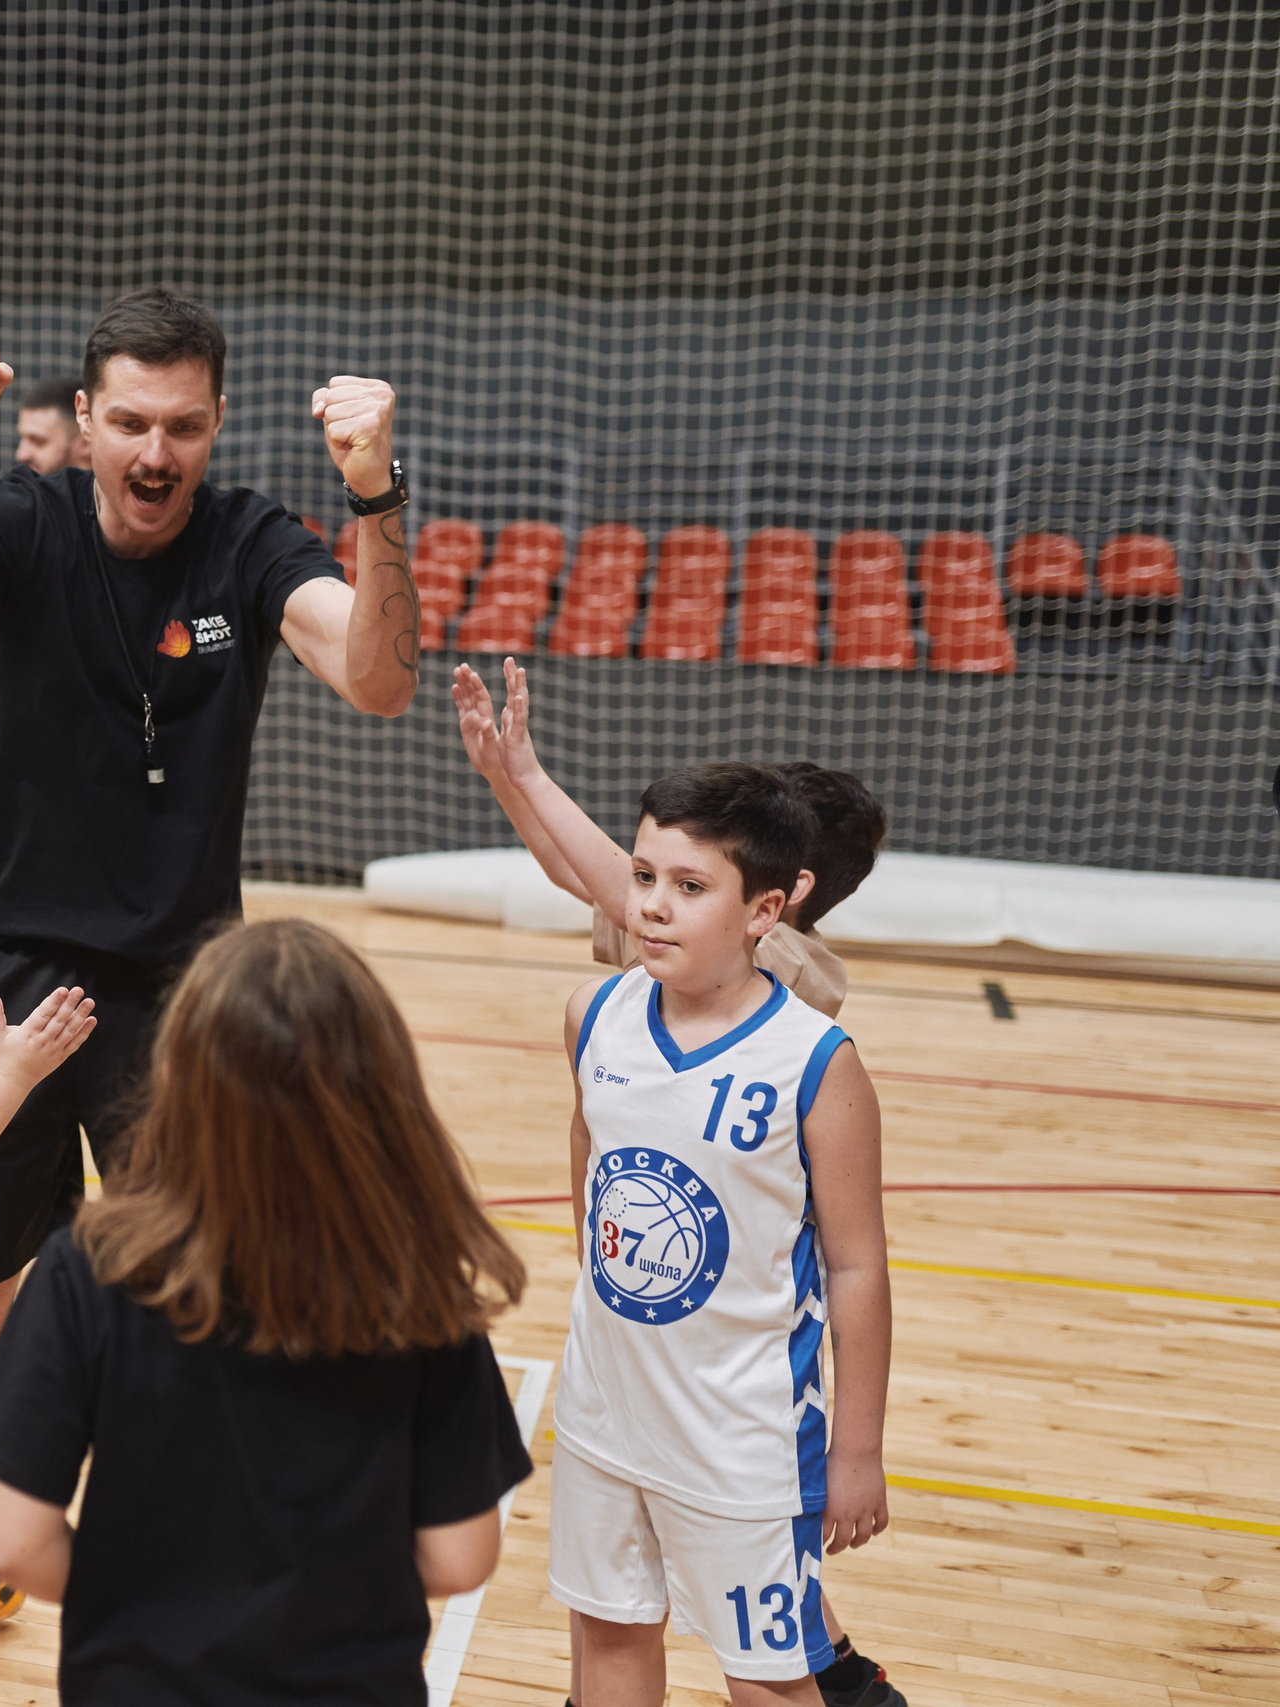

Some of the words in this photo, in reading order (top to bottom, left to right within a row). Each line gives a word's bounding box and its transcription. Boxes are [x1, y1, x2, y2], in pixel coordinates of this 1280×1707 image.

[191, 614, 227, 631] TAKE
[195, 626, 232, 644] SHOT
[702, 1073, 779, 1152] 13
[595, 1151, 719, 1223] МОСКВА
[601, 1220, 646, 1268] 37
[639, 1257, 683, 1281] школа
[725, 1583, 799, 1652] 13
